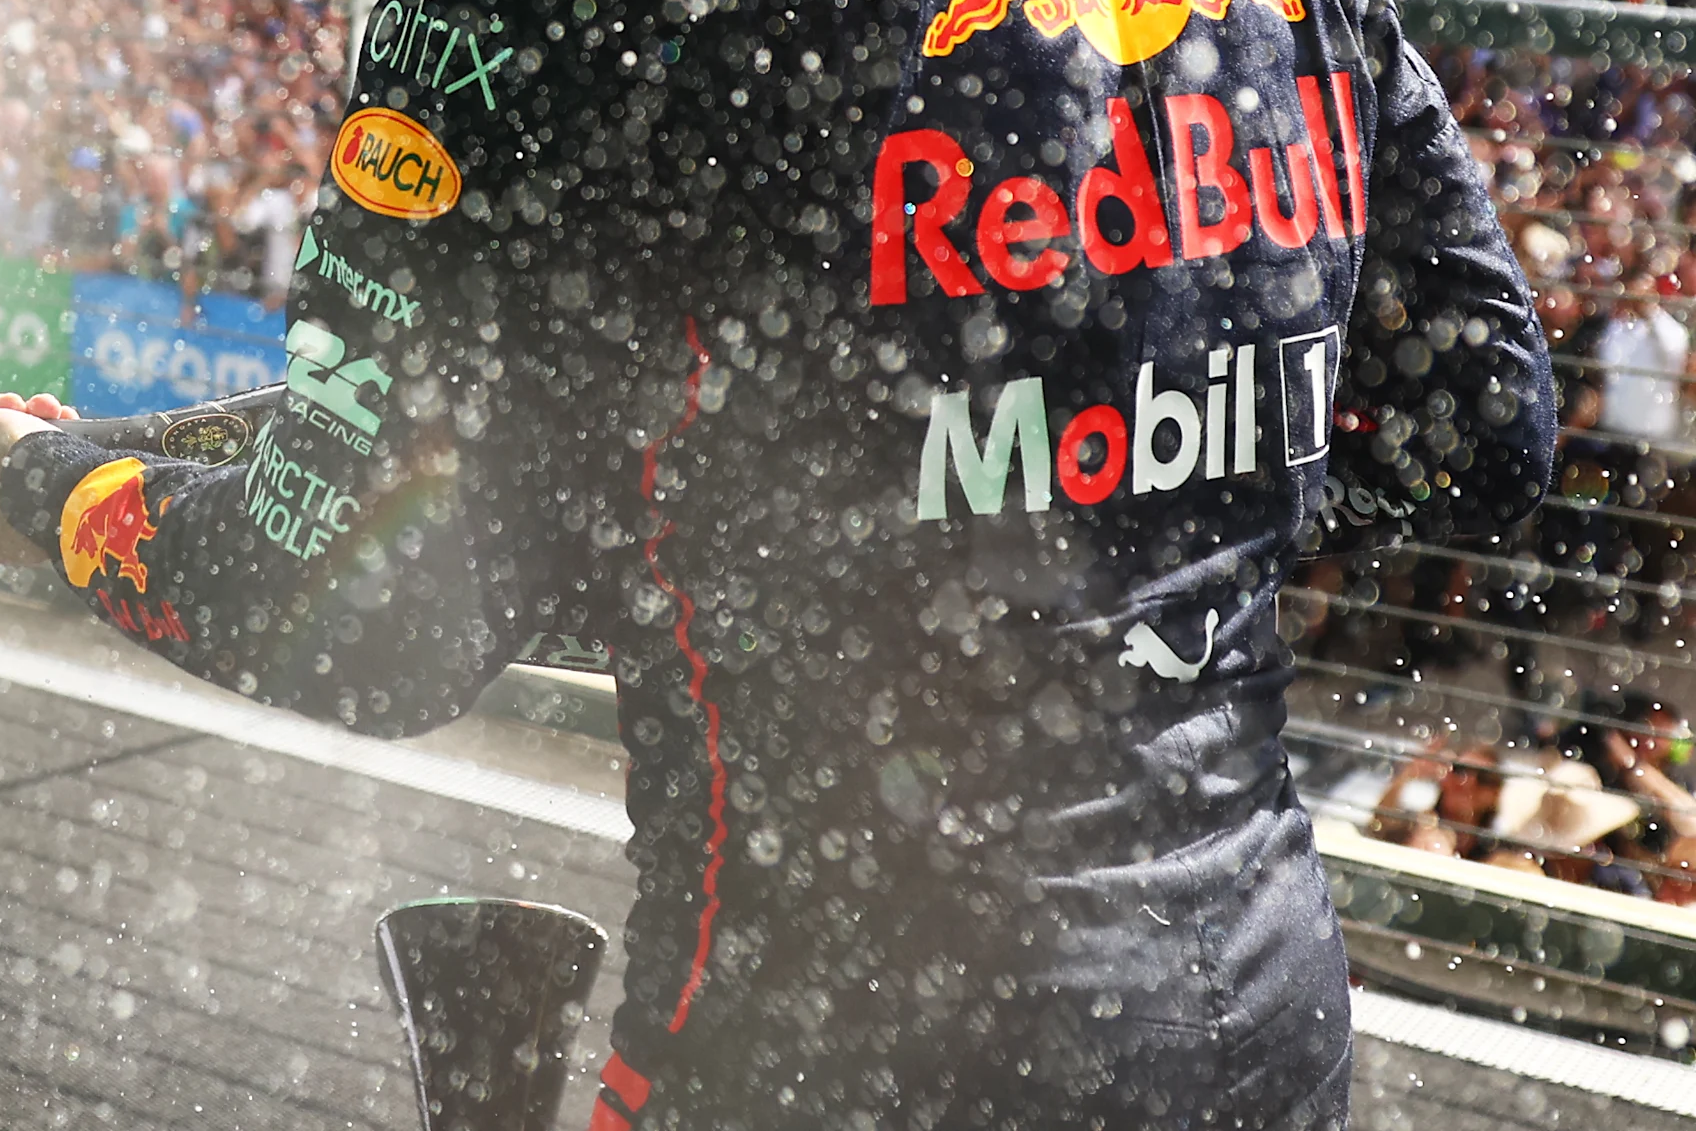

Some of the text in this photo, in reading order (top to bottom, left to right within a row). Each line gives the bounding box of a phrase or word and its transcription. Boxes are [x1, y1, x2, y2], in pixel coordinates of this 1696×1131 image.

[356, 133, 445, 203] RAUCH
[916, 341, 1328, 522] Mobil 1
[248, 478, 333, 561] WOLF
[262, 434, 361, 534] ARCTIC
